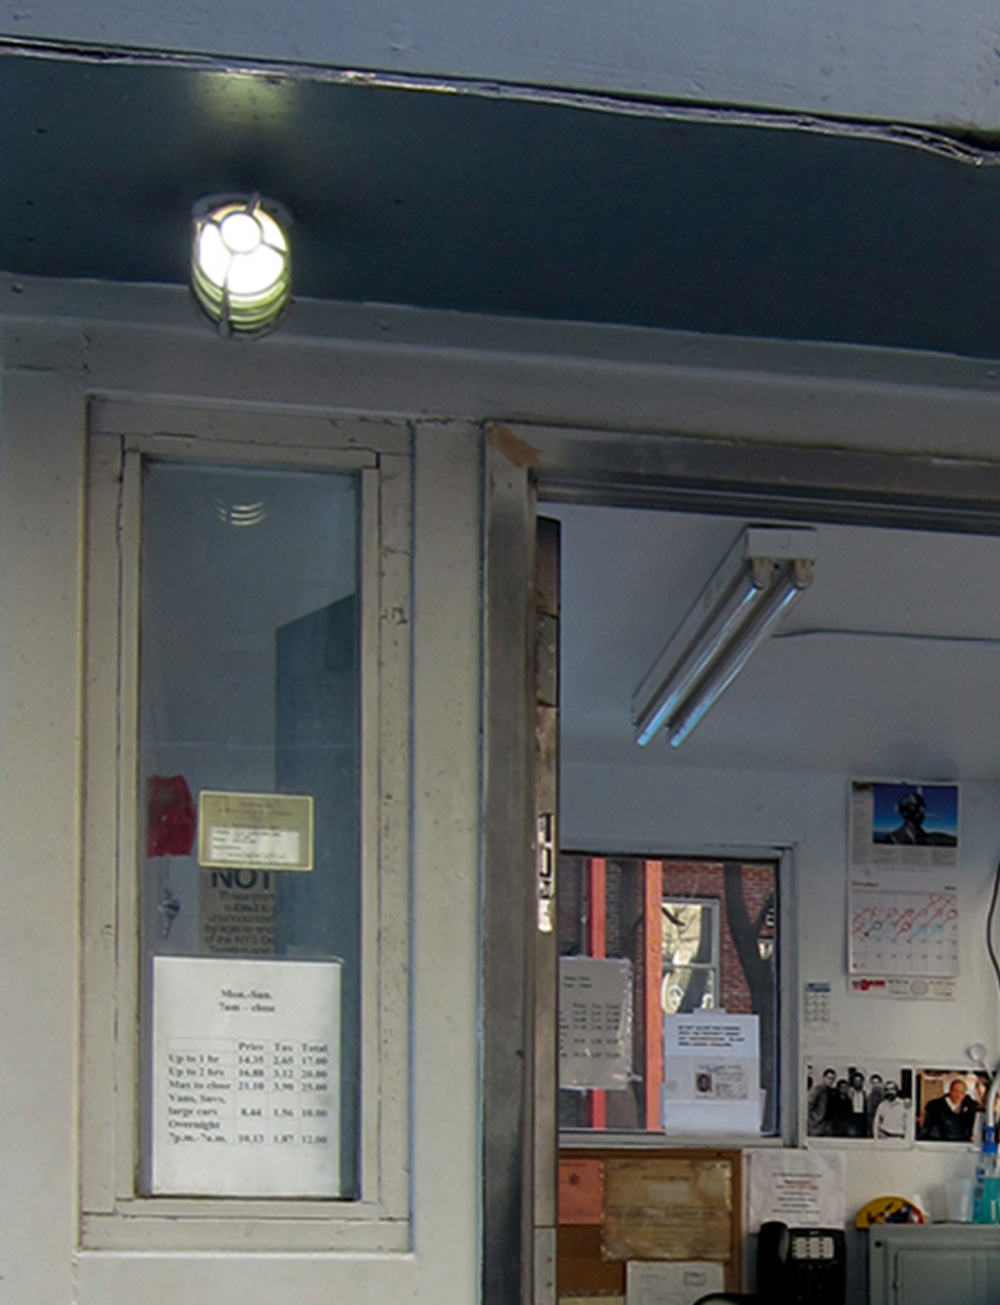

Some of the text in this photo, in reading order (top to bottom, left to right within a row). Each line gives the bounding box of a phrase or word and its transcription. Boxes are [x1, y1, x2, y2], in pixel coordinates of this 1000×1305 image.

[219, 1002, 240, 1012] 7am
[251, 1003, 275, 1012] close
[239, 1042, 328, 1053] Price Tax Total
[168, 1054, 184, 1065] Up
[187, 1054, 196, 1063] to
[207, 1054, 219, 1063] hr
[302, 1056, 328, 1065] 17.00
[168, 1067, 184, 1078] Up
[187, 1068, 196, 1076] to
[207, 1067, 224, 1076] hrs
[302, 1069, 328, 1079] 20.00
[194, 1081, 204, 1089] to
[206, 1081, 231, 1090] close
[302, 1082, 328, 1092] 25.00
[197, 1108, 218, 1116] cars
[302, 1108, 328, 1118] 10.00
[168, 1120, 220, 1131] Overnight
[302, 1134, 328, 1144] 12.00
